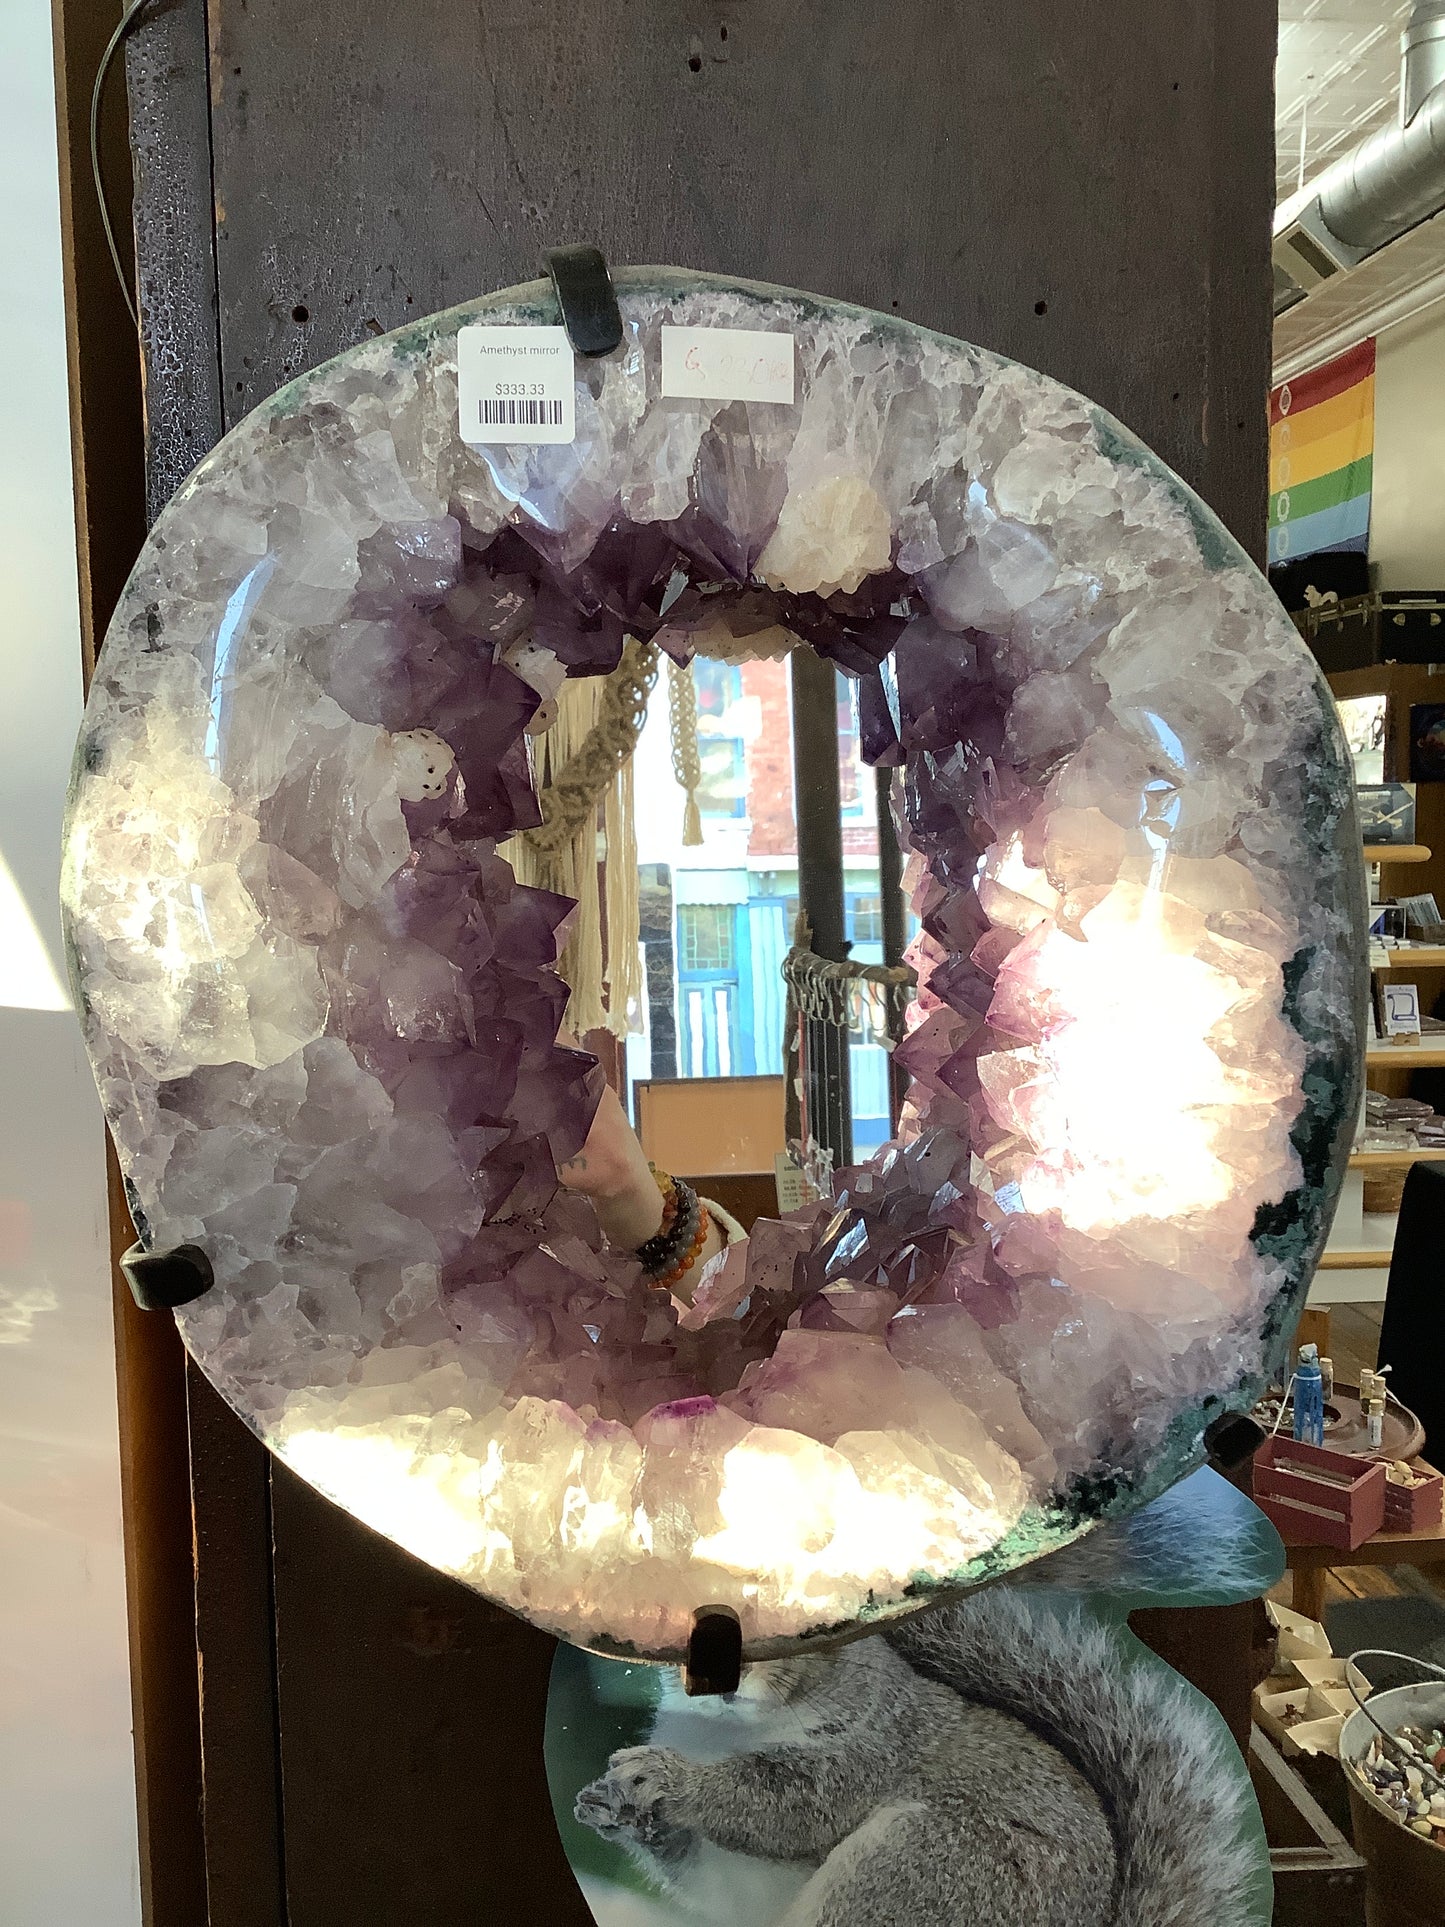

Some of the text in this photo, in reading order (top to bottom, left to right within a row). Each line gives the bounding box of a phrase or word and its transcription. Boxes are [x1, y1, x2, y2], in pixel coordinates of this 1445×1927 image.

[480, 345, 560, 357] Amethyst mirror
[495, 382, 545, 396] $333.33
